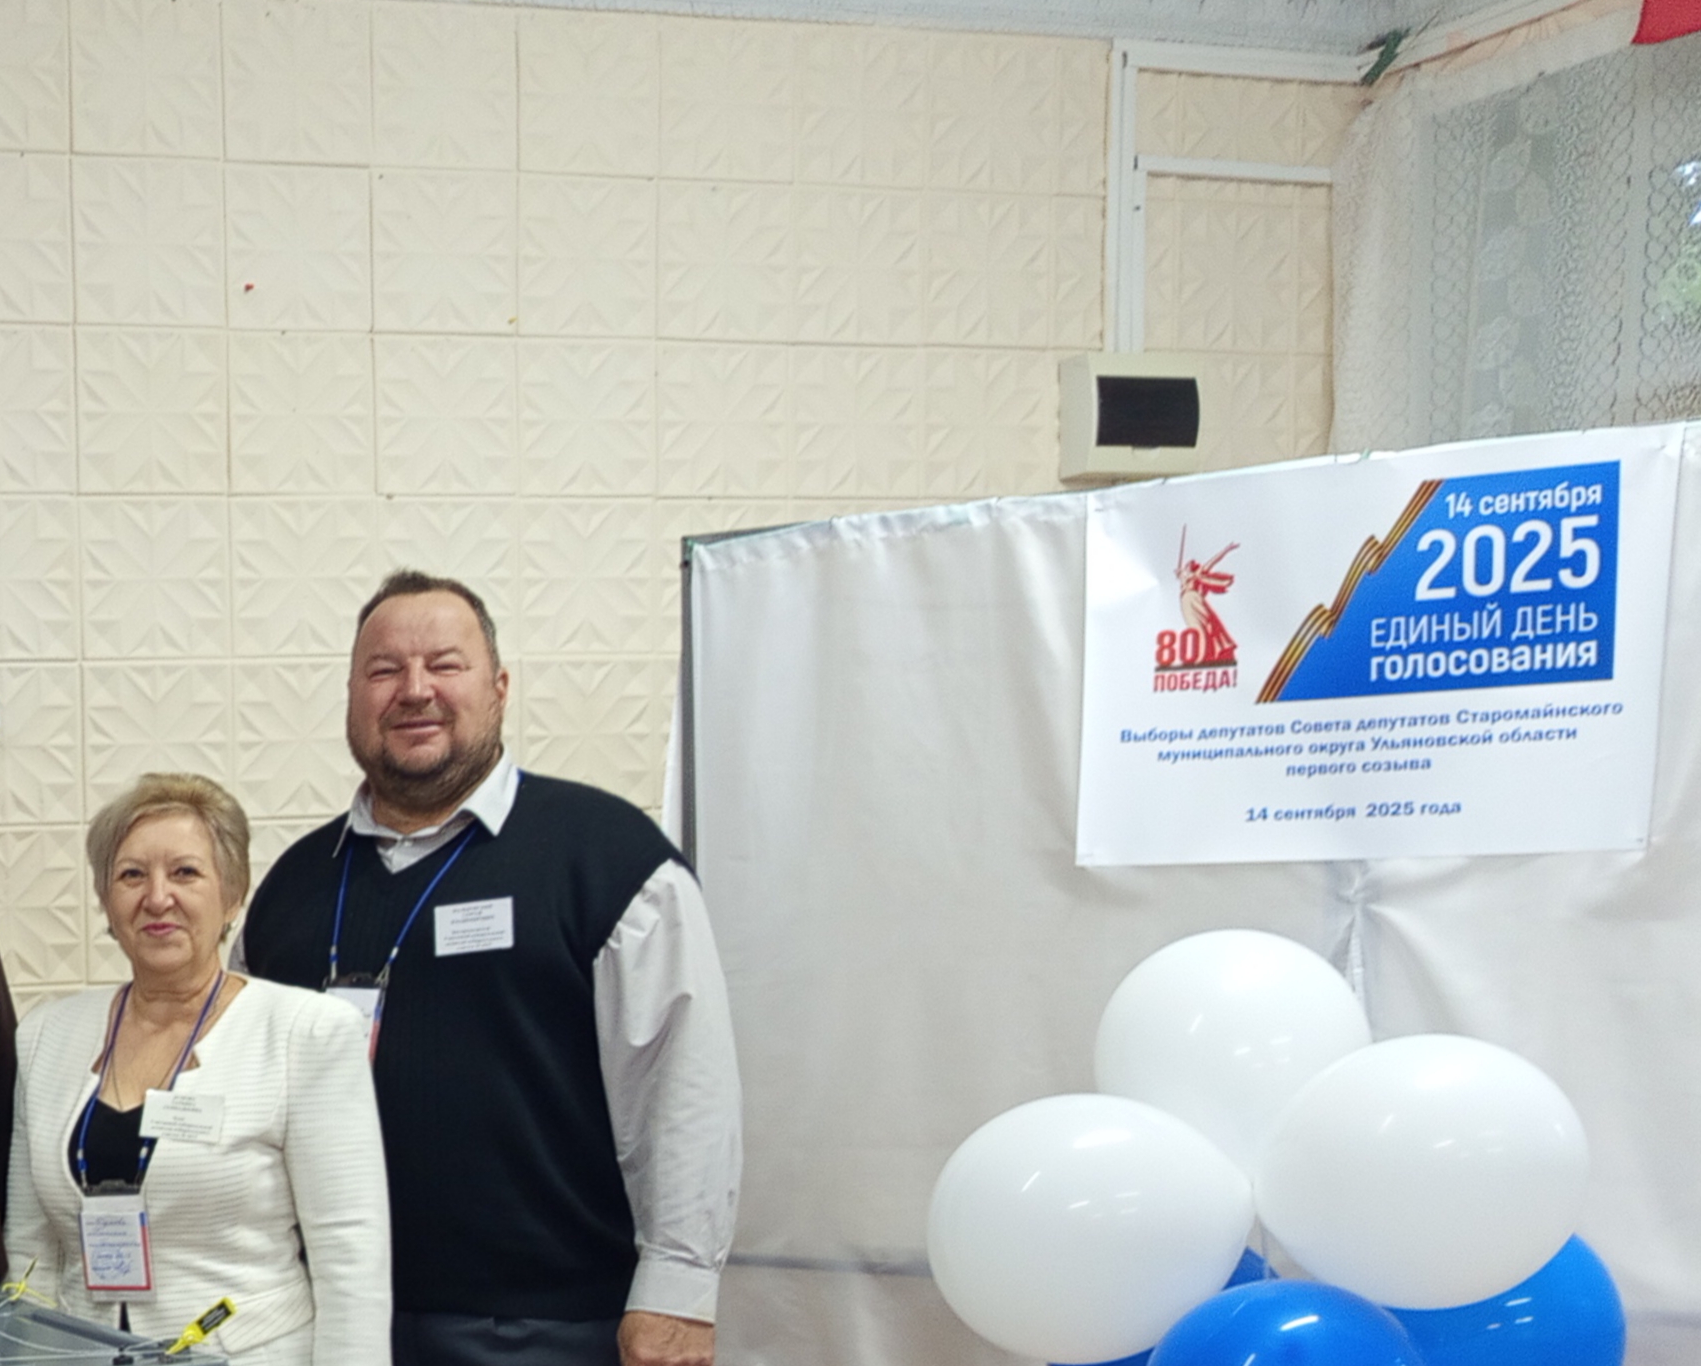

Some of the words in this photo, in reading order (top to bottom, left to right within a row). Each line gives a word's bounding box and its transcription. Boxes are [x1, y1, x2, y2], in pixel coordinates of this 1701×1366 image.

[1445, 491, 1473, 518] 14
[1479, 481, 1602, 515] сентября
[1415, 514, 1601, 601] 2025
[1370, 602, 1502, 650] ЕДИНЫЙ
[1511, 602, 1598, 641] ДЕНЬ
[1155, 628, 1201, 667] 80
[1369, 640, 1598, 682] голосования
[1153, 668, 1238, 693] ПОБЕДА!
[1120, 727, 1193, 744] Выборы
[1197, 723, 1285, 741] депутатов
[1290, 718, 1351, 735] Совета
[1356, 711, 1450, 732] депутатов
[1456, 702, 1624, 725] Старомайнского
[1157, 744, 1303, 764] муниципального
[1308, 739, 1365, 756] округа
[1370, 730, 1493, 751] Ульяновской
[1498, 726, 1577, 744] области
[1286, 762, 1356, 778] первого
[1361, 757, 1432, 773] созыва
[1245, 807, 1268, 822] 14
[1273, 802, 1356, 821] сентября
[1365, 800, 1415, 818] 2025
[1420, 801, 1462, 816] года
